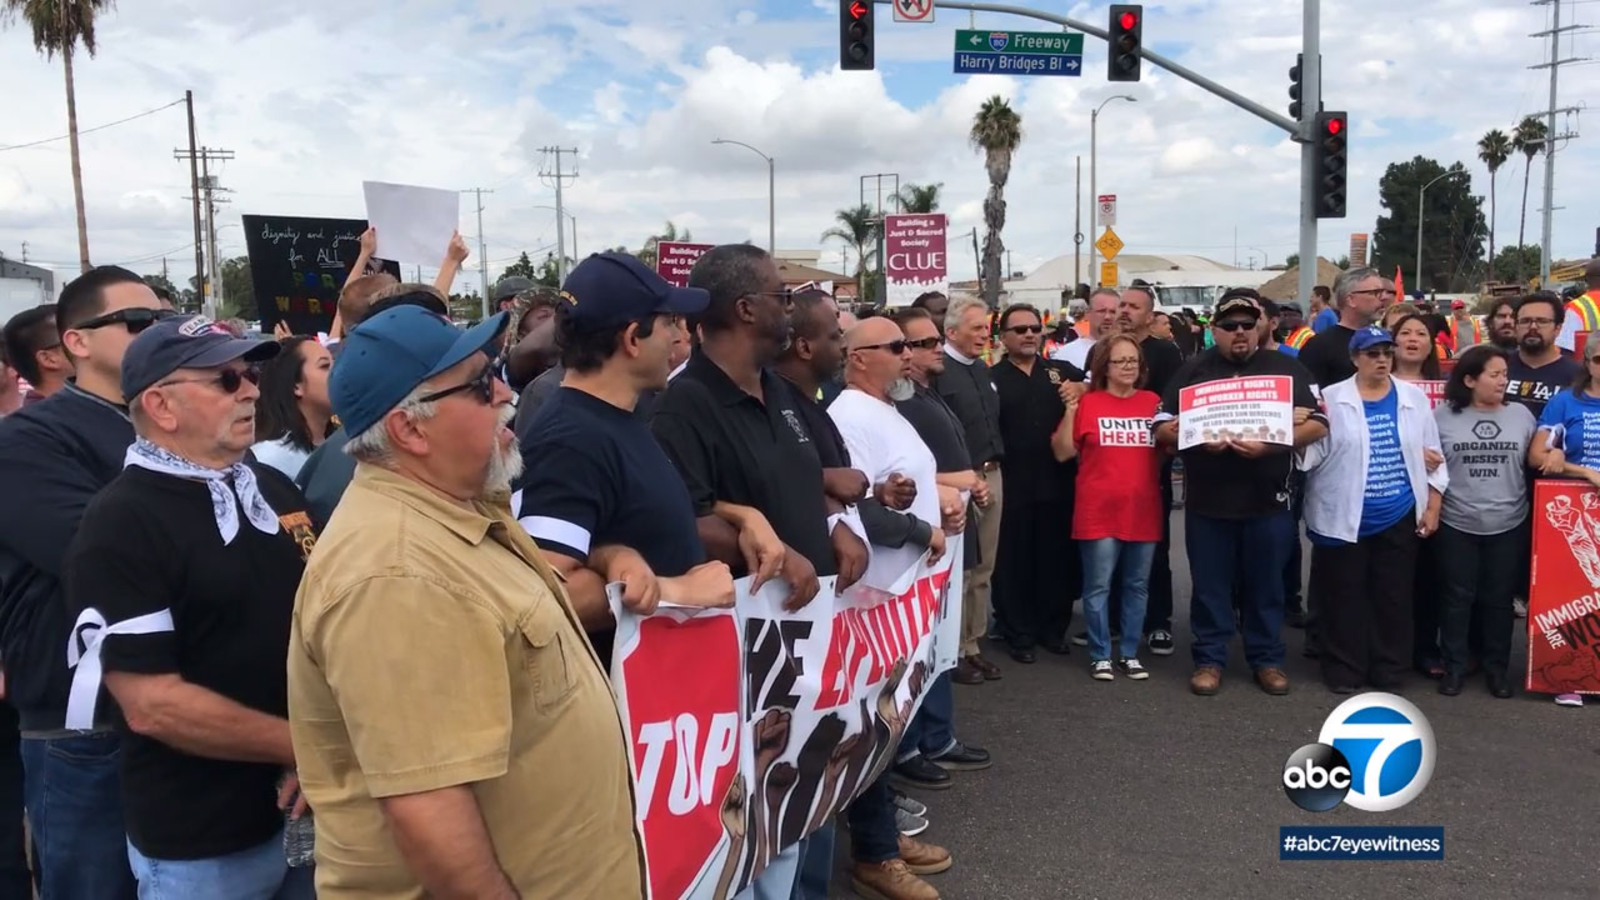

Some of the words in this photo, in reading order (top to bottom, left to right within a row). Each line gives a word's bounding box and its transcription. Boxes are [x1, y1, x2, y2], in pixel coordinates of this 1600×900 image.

[1014, 34, 1070, 52] Freeway
[960, 55, 995, 71] Harry
[999, 56, 1045, 73] Bridges
[896, 219, 928, 228] Building
[261, 223, 300, 244] dignity
[307, 228, 325, 239] and
[288, 248, 305, 269] for
[316, 248, 342, 263] ALL
[669, 247, 699, 257] Building
[661, 257, 678, 265] Just
[889, 252, 945, 271] CLUE
[1194, 381, 1241, 396] IMMIGRANT
[1243, 380, 1275, 389] RIGHTS
[1192, 396, 1207, 407] ARE
[1208, 392, 1244, 403] WORKER
[1246, 390, 1278, 400] RIGHTS
[1249, 410, 1282, 419] DERECHOS
[1101, 419, 1152, 430] UNITE
[1102, 431, 1153, 445] HERE!
[1453, 442, 1518, 452] ORGANIZE
[1462, 455, 1510, 464] RESIST.
[1469, 468, 1500, 478] WIN.
[1544, 627, 1567, 650] ARE
